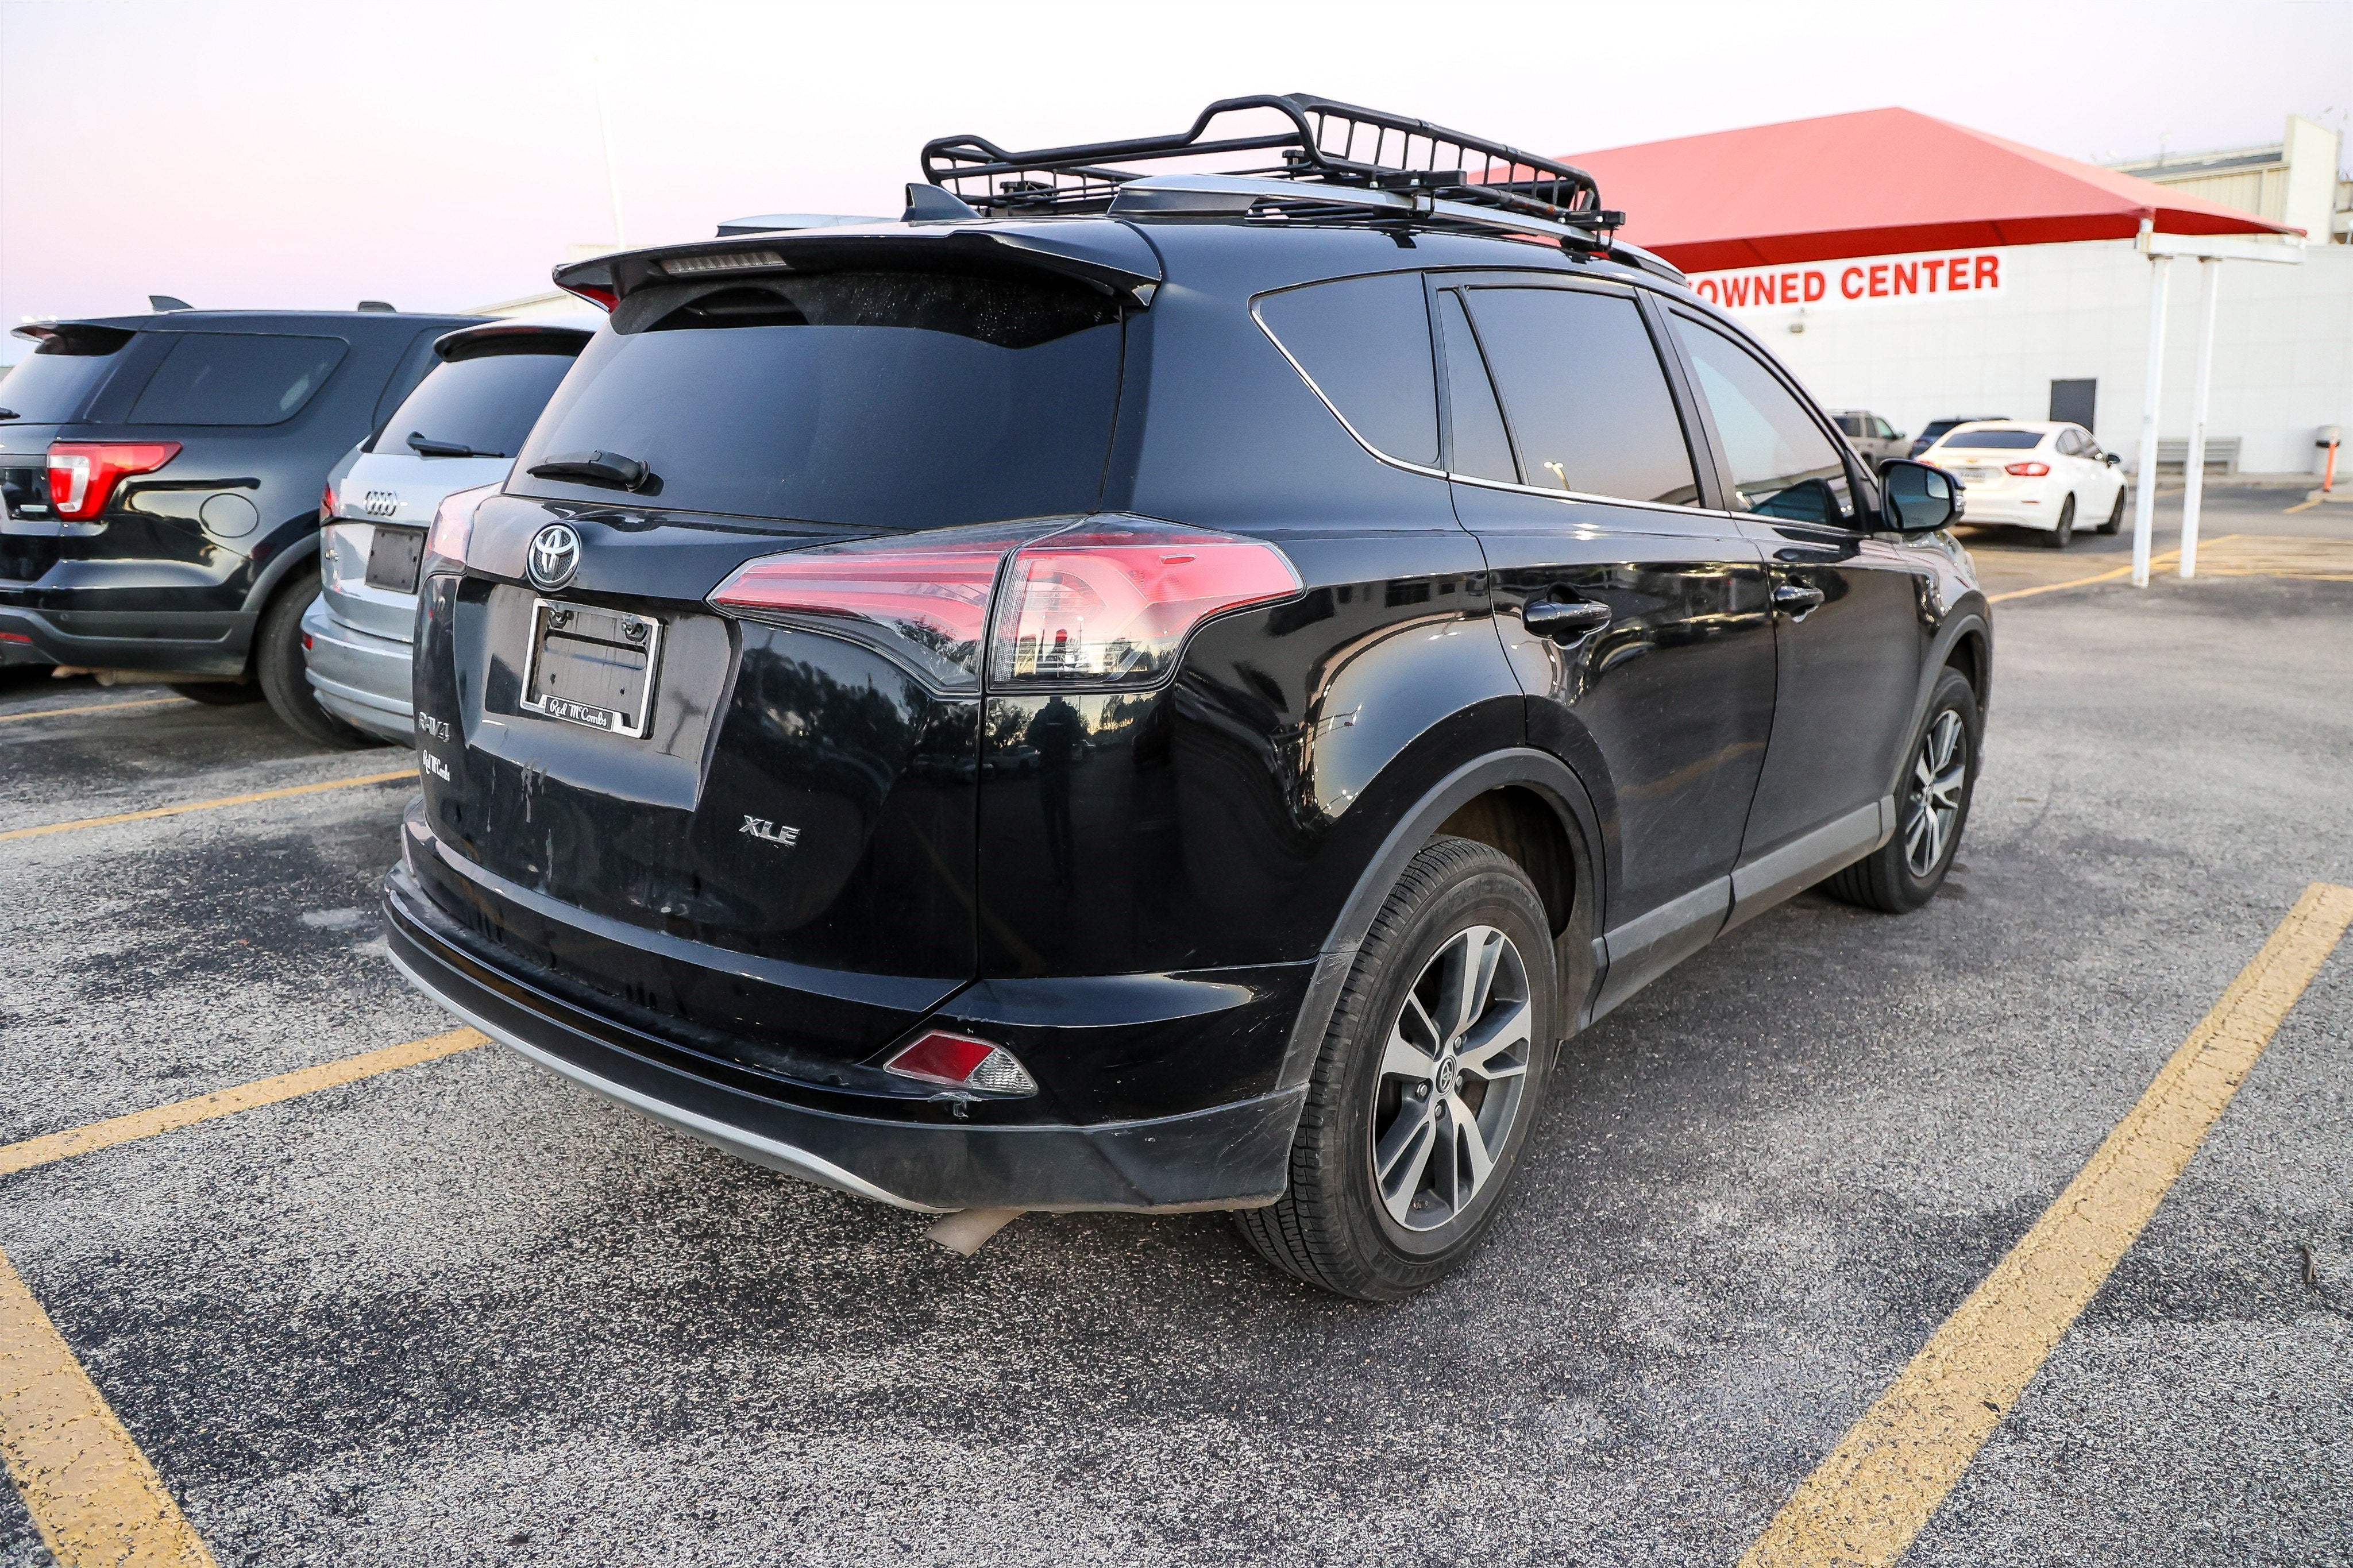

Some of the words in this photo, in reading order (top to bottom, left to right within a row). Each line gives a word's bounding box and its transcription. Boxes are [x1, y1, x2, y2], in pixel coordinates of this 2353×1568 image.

[1688, 271, 1826, 307] OWNED
[1841, 254, 1999, 300] CENTER
[418, 711, 450, 743] RAV4
[549, 698, 568, 717] Red
[568, 702, 608, 727] McCombs
[738, 814, 801, 847] XLE
